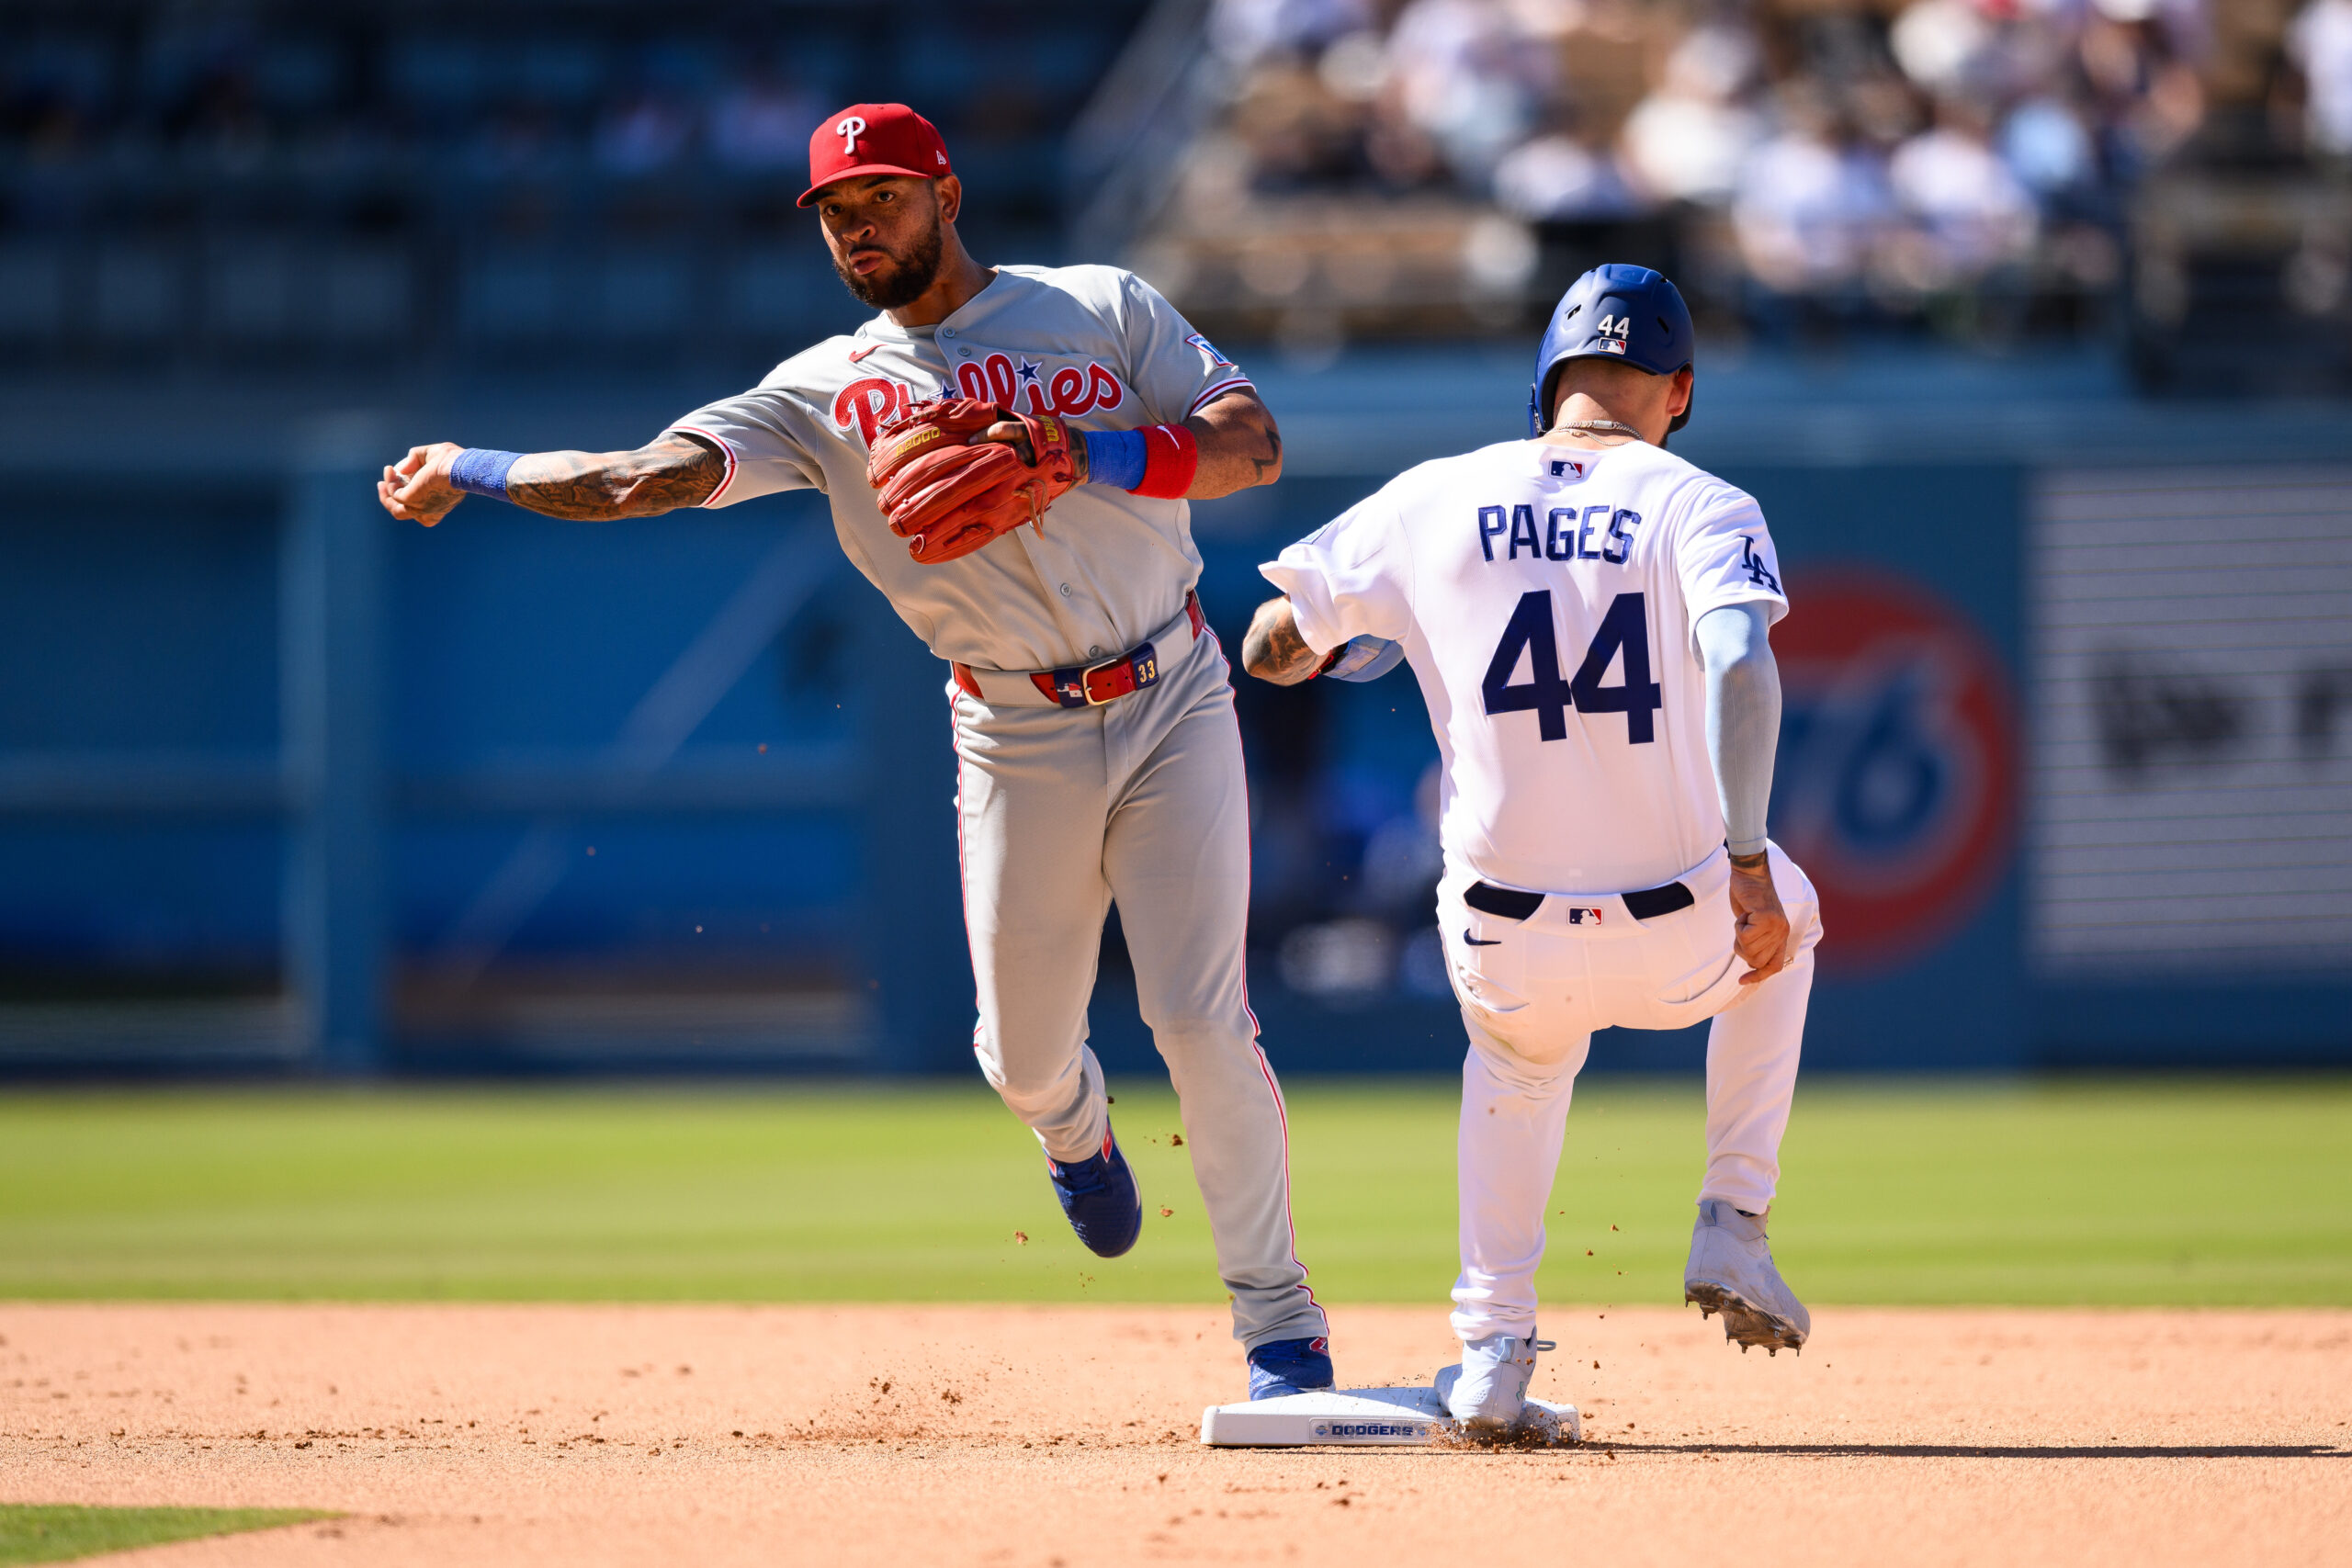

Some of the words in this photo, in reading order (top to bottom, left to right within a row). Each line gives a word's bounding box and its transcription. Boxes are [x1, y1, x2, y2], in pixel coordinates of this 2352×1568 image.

[836, 116, 866, 154] P
[1598, 313, 1630, 340] 44
[896, 426, 941, 458] A2000
[1479, 504, 1641, 564] PAGES
[1739, 535, 1781, 595] LA
[1138, 660, 1156, 683] 33
[1482, 590, 1662, 744] 44
[1331, 1425, 1414, 1436] DODGERS
